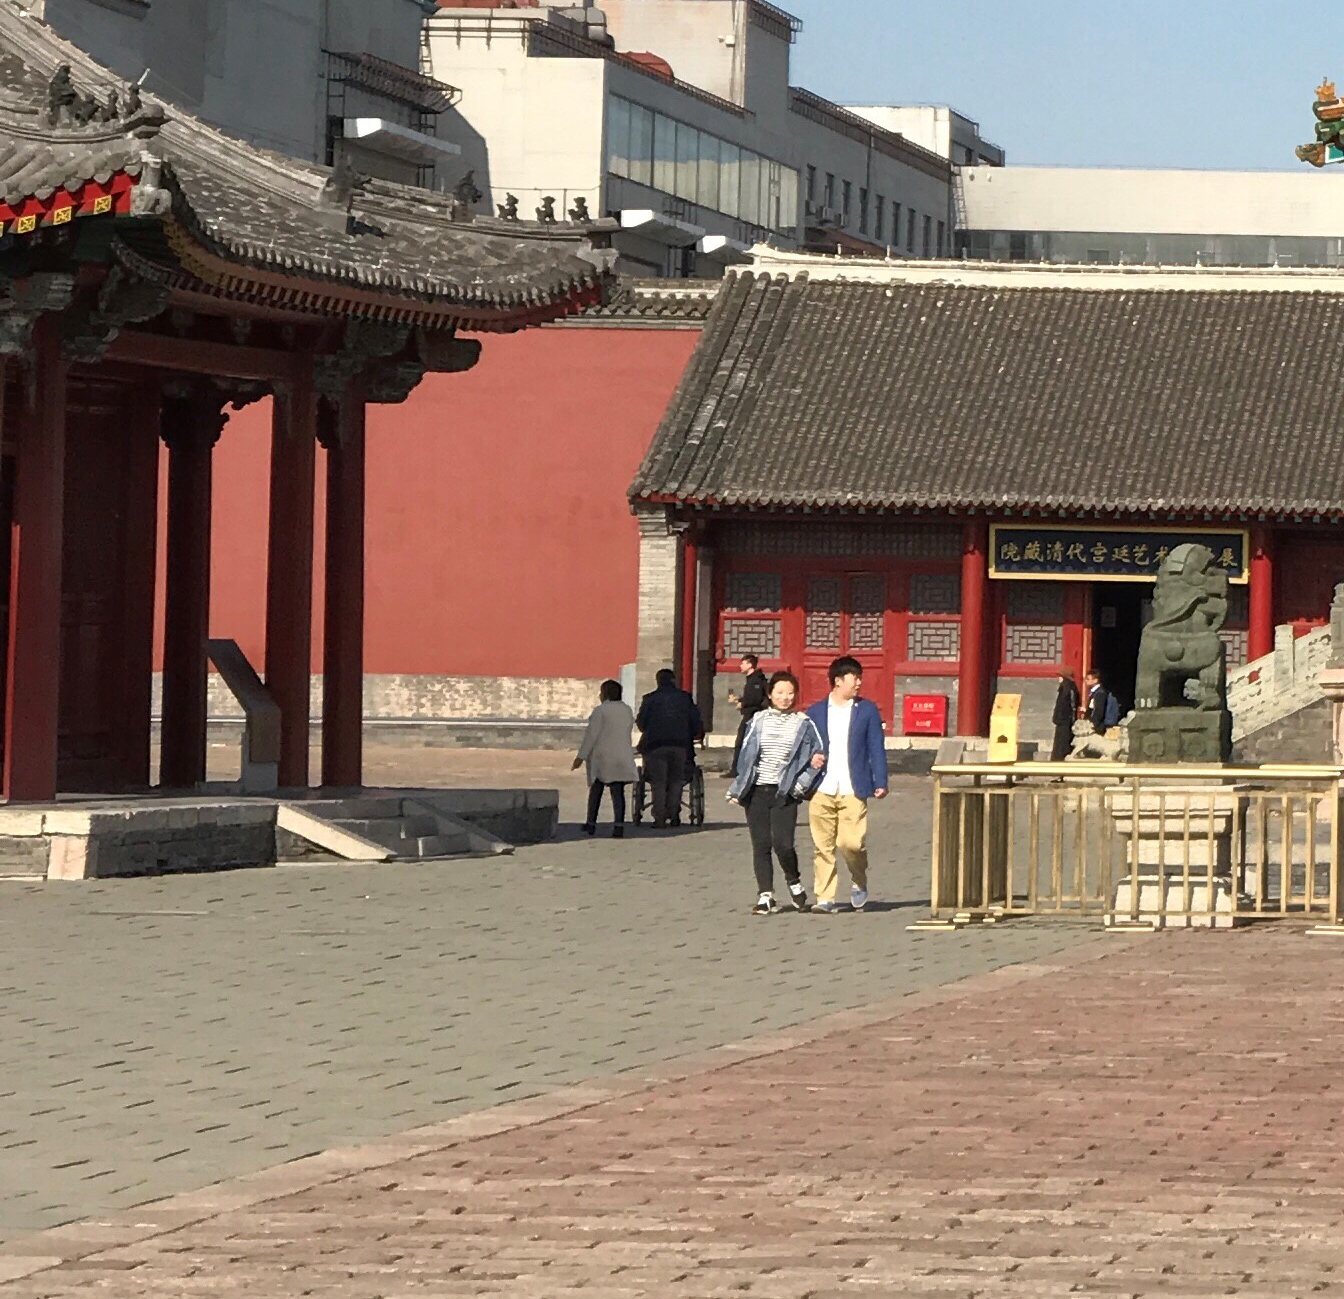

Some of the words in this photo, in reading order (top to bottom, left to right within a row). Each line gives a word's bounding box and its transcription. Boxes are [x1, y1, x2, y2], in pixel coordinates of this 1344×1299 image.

[1000, 541, 1238, 567] 院藏清代宫廷艺术展
